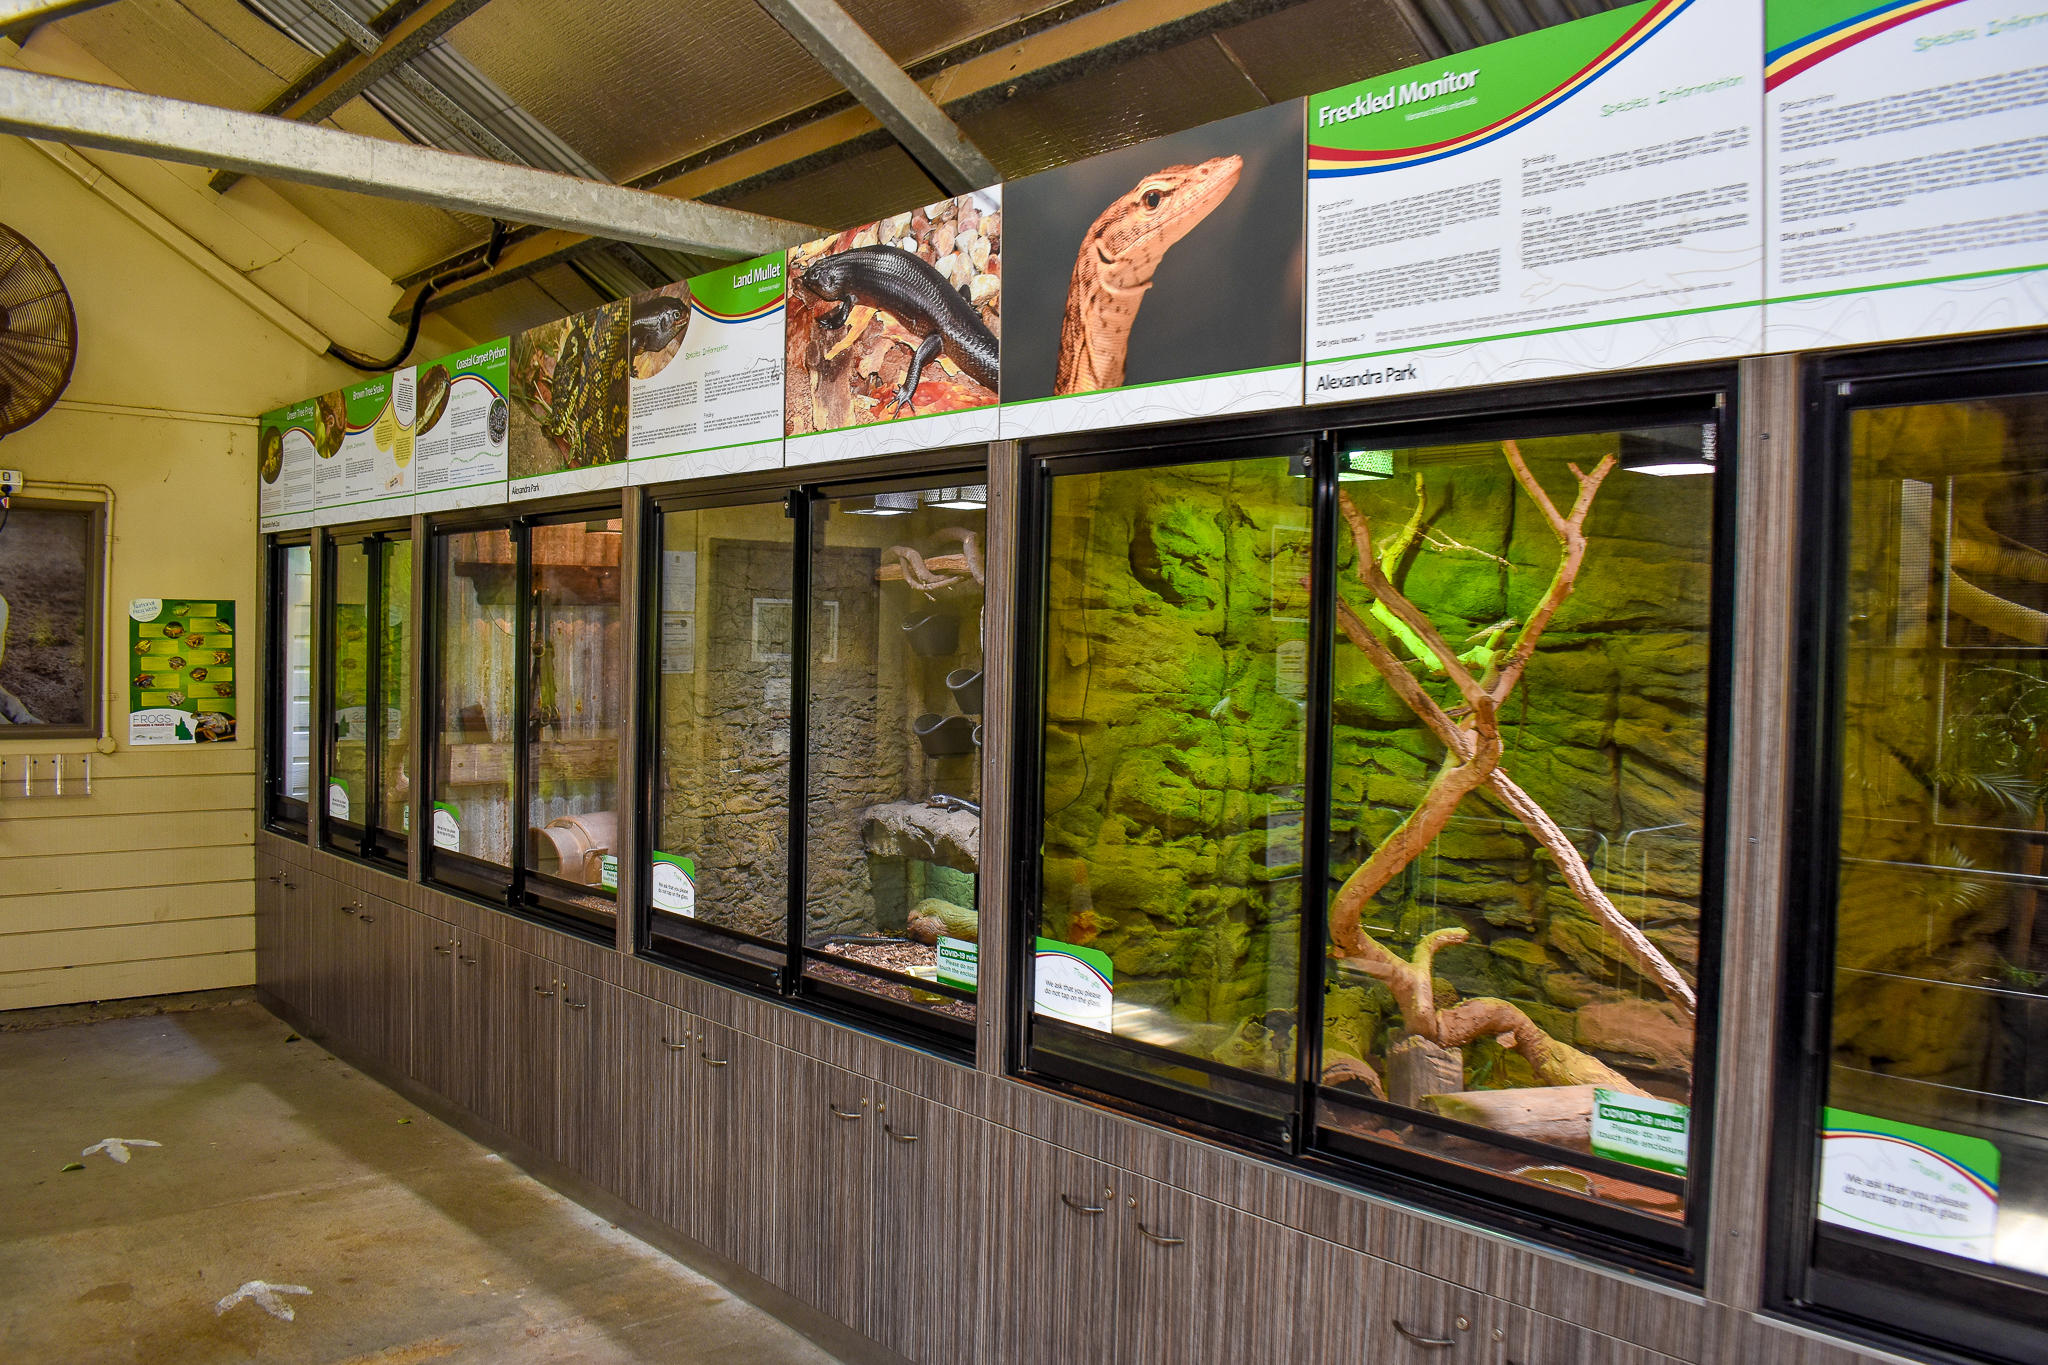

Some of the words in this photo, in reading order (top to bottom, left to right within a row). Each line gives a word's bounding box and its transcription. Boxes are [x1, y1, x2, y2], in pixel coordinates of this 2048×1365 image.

[1319, 85, 1396, 128] Freckled
[1398, 69, 1480, 107] Monitor
[1656, 75, 1746, 105] Information
[733, 268, 753, 290] Land
[753, 262, 781, 284] Mullet
[456, 354, 473, 370] Coastal
[473, 350, 489, 367] Carpet
[489, 346, 507, 363] Python
[1315, 368, 1383, 392] Alexandra
[1385, 363, 1418, 383] Park
[353, 390, 365, 401] Brown
[365, 387, 373, 396] Tree
[373, 382, 385, 395] Snake
[286, 411, 297, 421] Green
[297, 408, 305, 418] Tree
[305, 406, 314, 417] Frog
[511, 484, 531, 495] Alexandra
[530, 482, 540, 493] Park
[133, 714, 173, 724] FROGS
[941, 949, 966, 960] COVID-19
[946, 959, 959, 967] Please
[1046, 980, 1054, 988] We
[1064, 985, 1074, 993] that
[1075, 988, 1084, 996] you
[1085, 989, 1102, 1000] please
[1062, 993, 1070, 1001] tap
[1079, 996, 1087, 1005] the
[1601, 1107, 1654, 1126] COVID-19
[1655, 1118, 1684, 1131] rules
[1842, 1186, 1859, 1196] do
[1861, 1190, 1879, 1201] not
[1881, 1195, 1900, 1208] tap
[1902, 1200, 1914, 1210] on
[1917, 1202, 1937, 1215] the
[1844, 1172, 1863, 1186] We
[1865, 1179, 1883, 1190] ask
[1885, 1183, 1909, 1196] that
[1910, 1191, 1929, 1201] you
[1931, 1194, 1971, 1211] please
